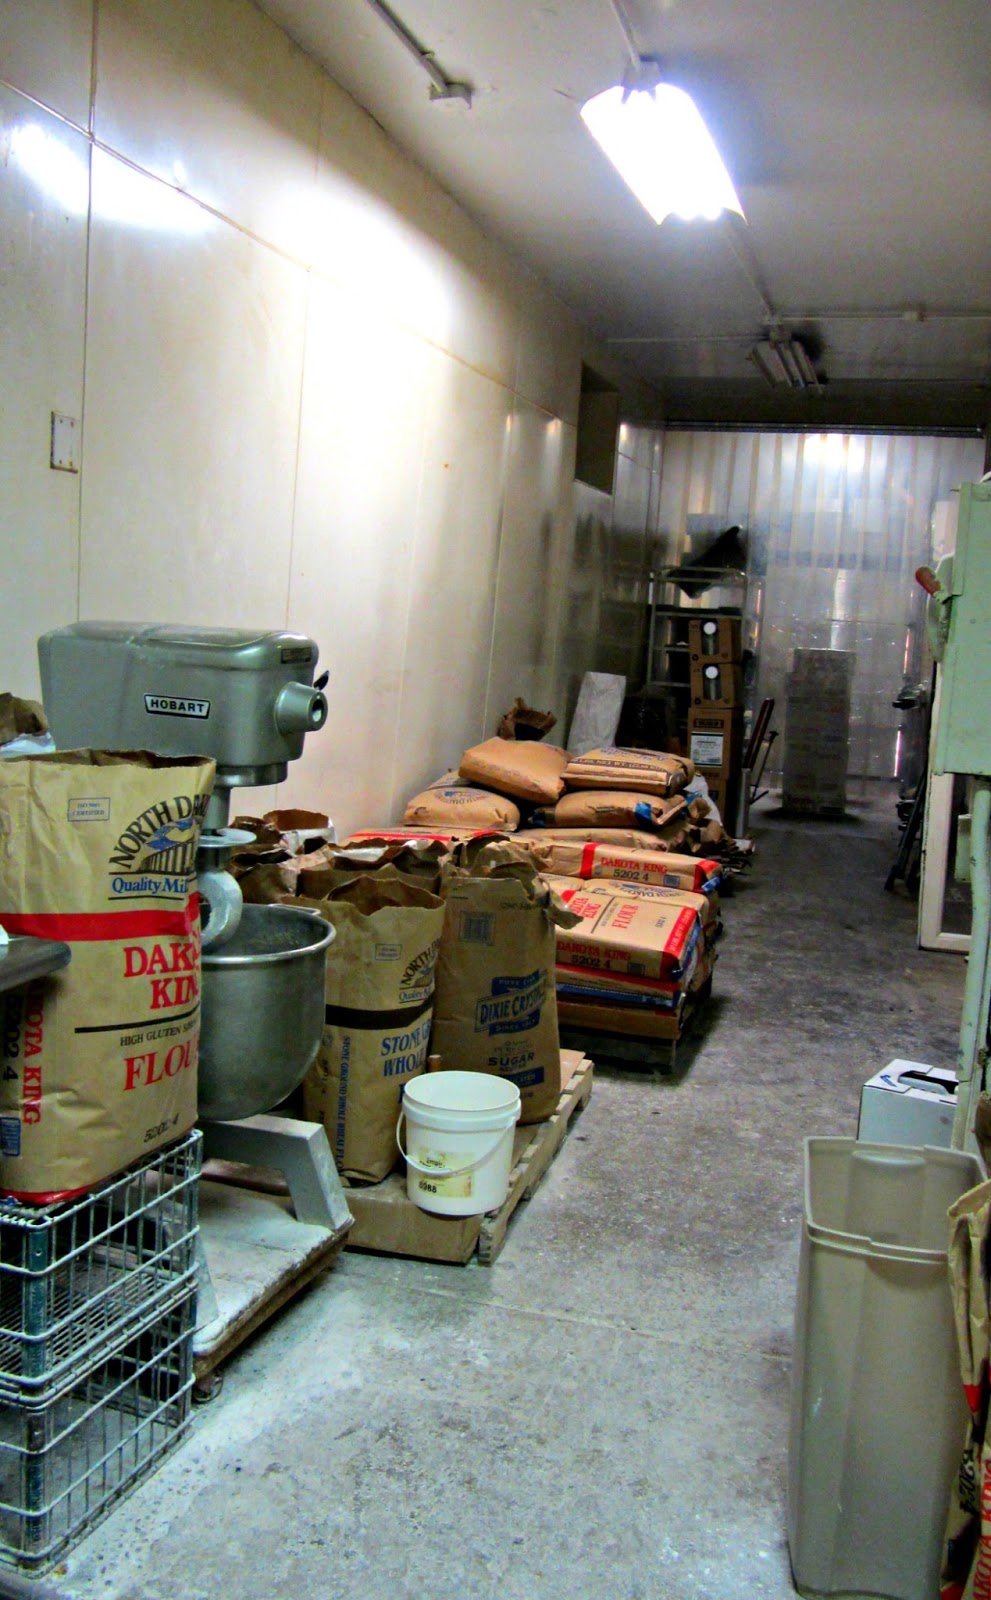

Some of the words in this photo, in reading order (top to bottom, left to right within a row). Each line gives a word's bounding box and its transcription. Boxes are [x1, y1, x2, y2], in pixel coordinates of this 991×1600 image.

[150, 698, 204, 712] HOBART
[109, 801, 173, 869] NORTH
[601, 857, 640, 870] DAKOTA
[643, 862, 668, 873] KING
[613, 869, 640, 880] 5202
[642, 873, 649, 881] 4
[112, 877, 162, 895] Quality
[611, 904, 639, 929] FLOUR
[401, 948, 431, 985] NORTH
[480, 1000, 511, 1024] DIXIE
[120, 1033, 144, 1047] HIGH
[146, 1026, 181, 1041] GLUTEN
[381, 1027, 421, 1056] STONE
[488, 1052, 535, 1066] SUGAR
[2, 1065, 19, 1082] 4
[22, 1065, 43, 1126] KING
